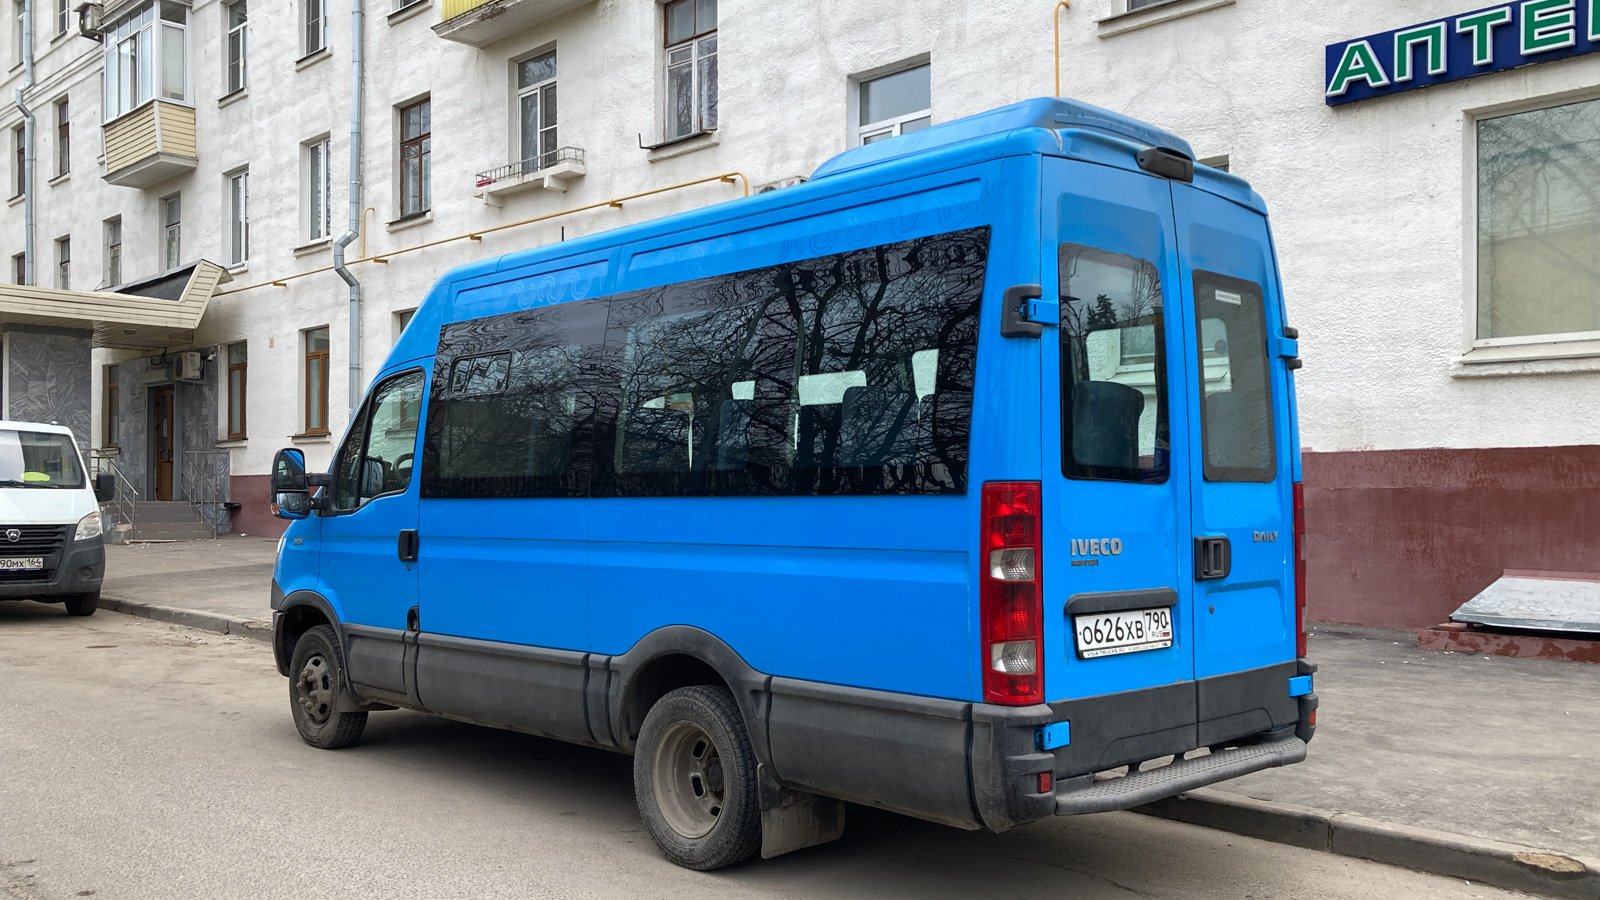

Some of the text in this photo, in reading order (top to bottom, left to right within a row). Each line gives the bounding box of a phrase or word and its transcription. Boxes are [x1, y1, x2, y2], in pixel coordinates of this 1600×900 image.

[1326, 0, 1600, 97] АПТЕ
[1253, 530, 1278, 543] DAILY
[1070, 537, 1123, 557] IVECO
[1145, 610, 1168, 631] 790
[1151, 630, 1163, 638] RUS
